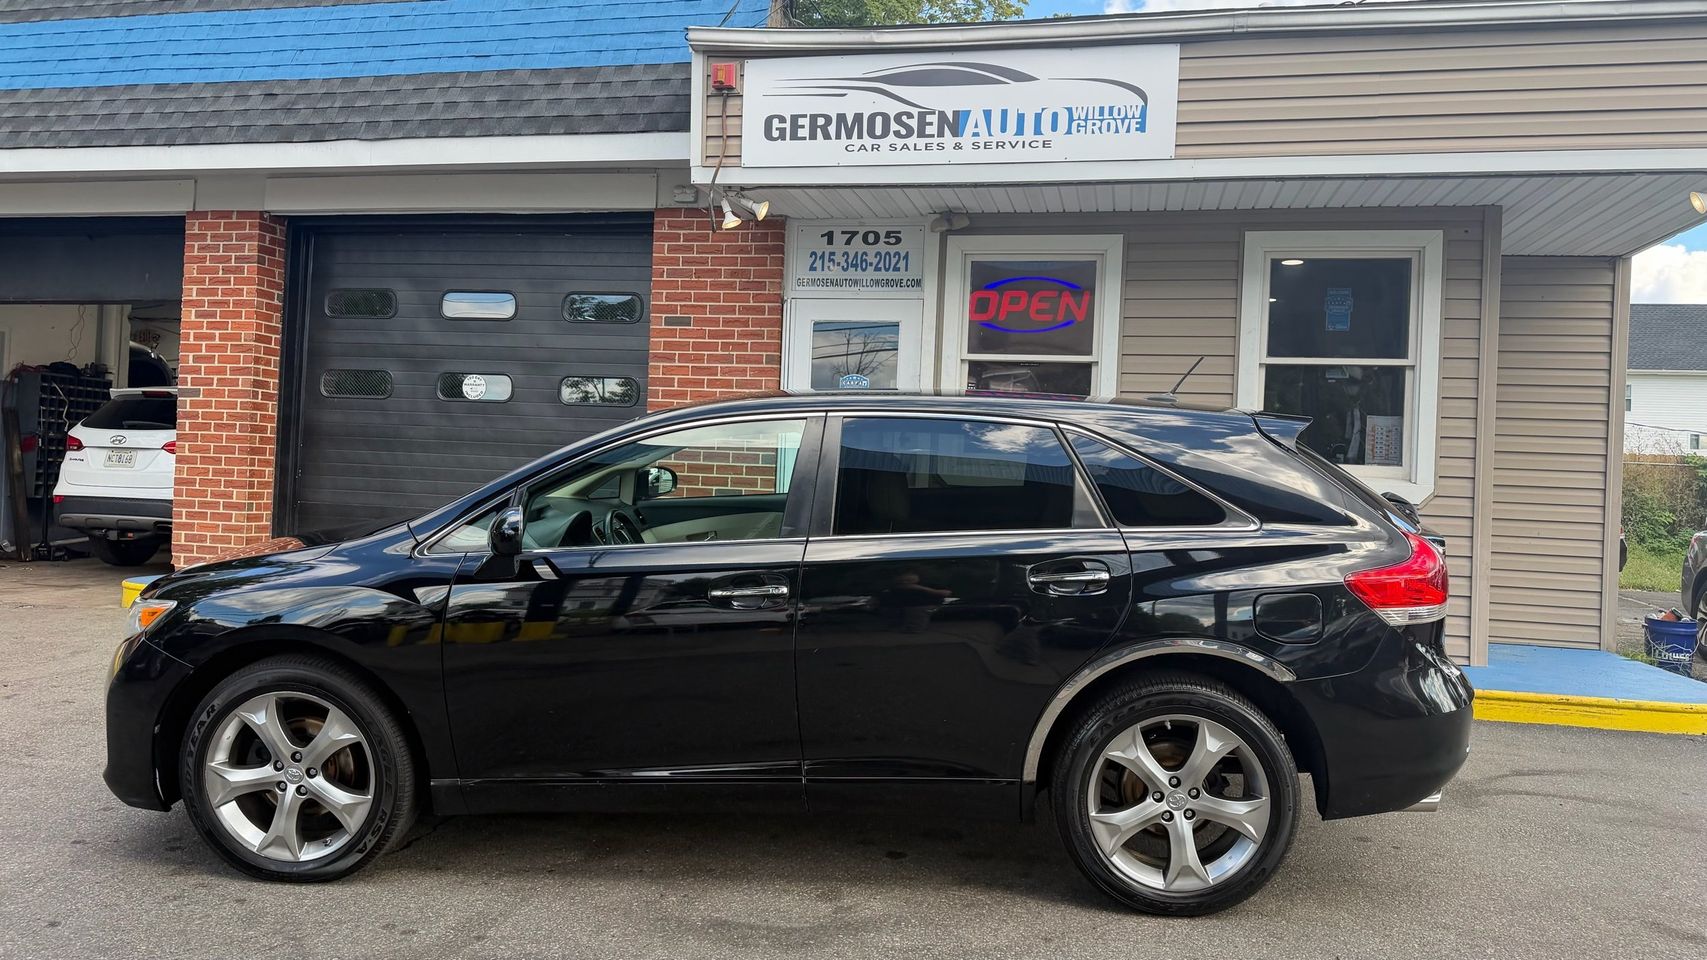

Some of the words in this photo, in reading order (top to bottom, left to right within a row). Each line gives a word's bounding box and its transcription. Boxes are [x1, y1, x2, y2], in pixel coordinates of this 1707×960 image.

[1071, 104, 1143, 119] WILLOW
[763, 110, 960, 141] GERMOSEN
[961, 106, 1068, 136] AUTO
[1071, 118, 1142, 134] GROVE
[844, 143, 881, 153] CAR
[888, 142, 946, 152] SALES
[952, 141, 964, 151] &
[971, 139, 1053, 150] SERVICE
[820, 230, 902, 246] 1705
[808, 250, 910, 272] 215-346-2021
[796, 277, 922, 288] GERMOSENAUTOWILLOWGROVE.COM
[969, 290, 1090, 321] OPEN
